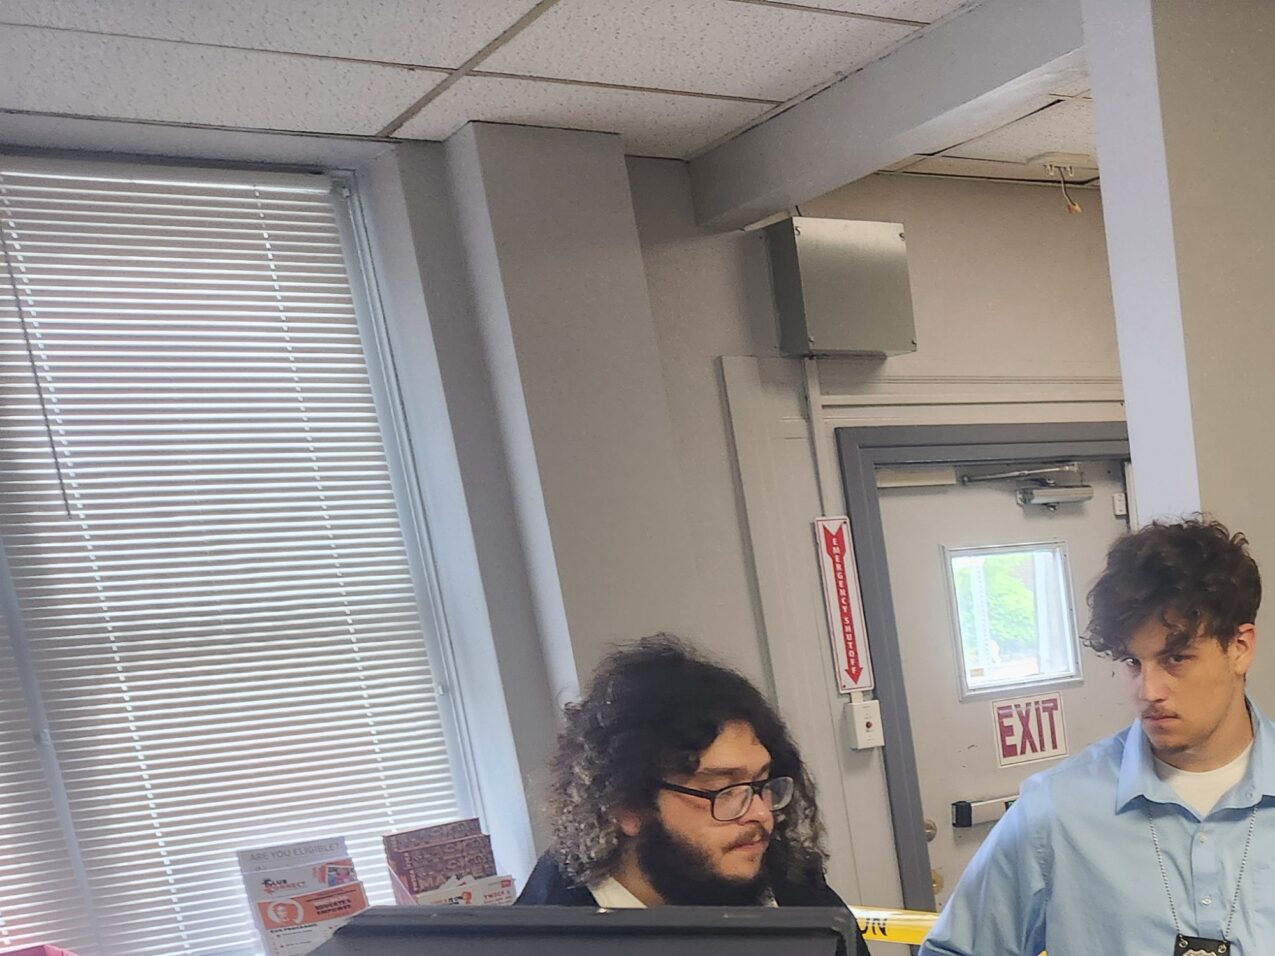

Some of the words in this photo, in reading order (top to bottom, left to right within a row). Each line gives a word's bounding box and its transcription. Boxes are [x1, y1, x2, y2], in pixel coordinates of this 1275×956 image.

[832, 537, 848, 614] EMERGENCY
[843, 616, 858, 674] SHUTOFF
[996, 698, 1059, 758] EXIT
[250, 851, 269, 861] ARE
[271, 848, 291, 858] YOU
[292, 842, 340, 856] ELIGIBLE?
